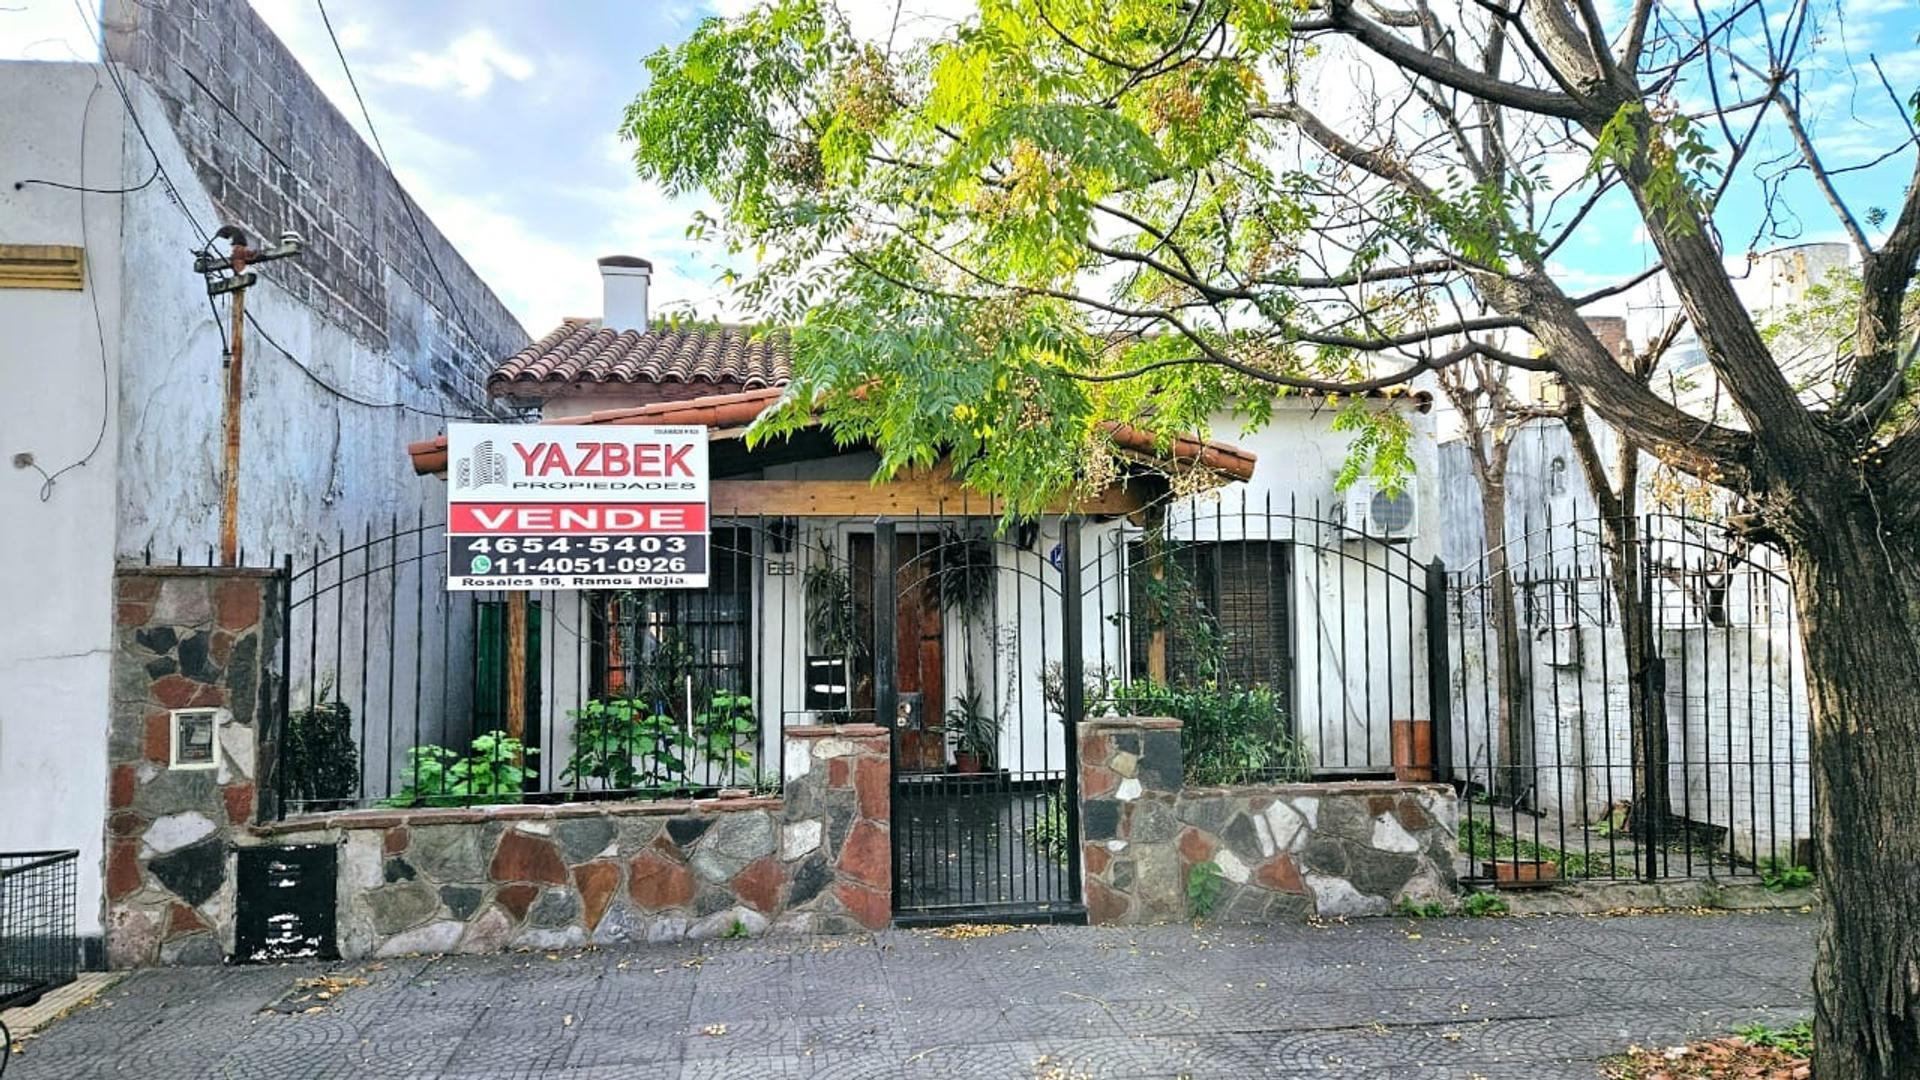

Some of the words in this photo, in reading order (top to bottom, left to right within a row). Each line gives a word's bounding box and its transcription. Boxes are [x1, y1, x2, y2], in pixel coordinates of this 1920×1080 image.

[512, 442, 696, 477] YAZBEK
[512, 481, 696, 490] PROPIEDADES
[470, 508, 686, 529] VENDE
[468, 536, 687, 553] 4654-5403
[494, 557, 686, 574] 11-4051-0926
[461, 577, 534, 587] Rosales
[573, 577, 633, 586] Ramos
